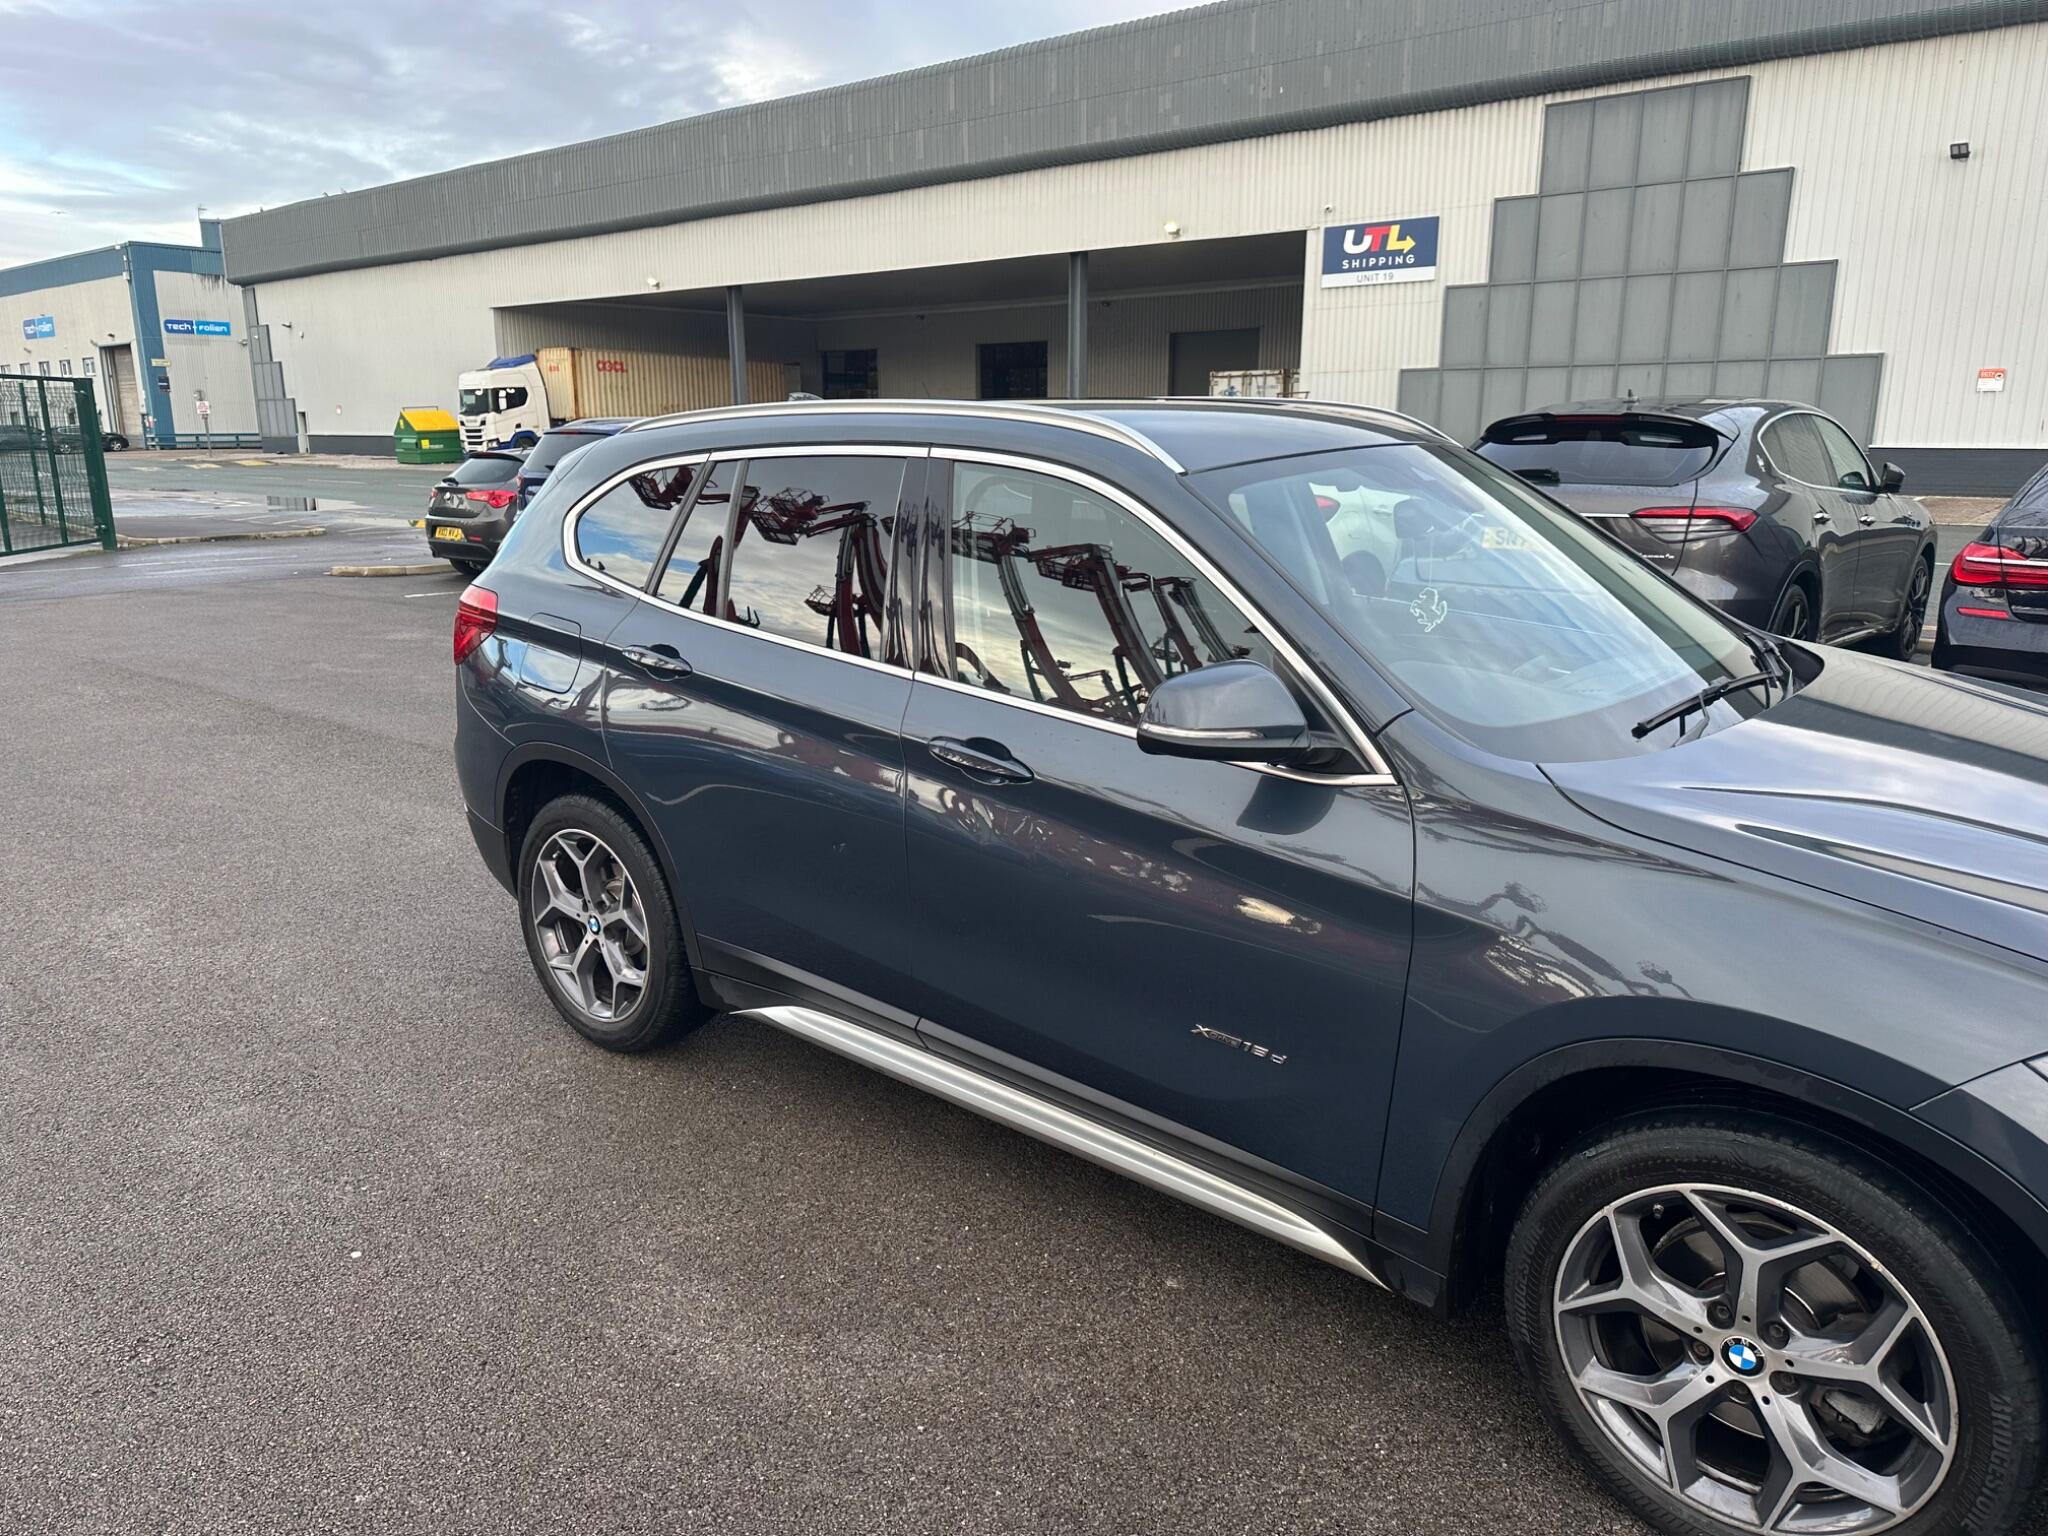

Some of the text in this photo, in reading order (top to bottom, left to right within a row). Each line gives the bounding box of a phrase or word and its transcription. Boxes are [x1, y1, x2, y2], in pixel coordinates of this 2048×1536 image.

[1343, 224, 1416, 254] UTL
[1342, 254, 1415, 269] SHIPPING
[1356, 271, 1395, 283] UNIT 19
[1726, 1338, 1765, 1357] BMW
